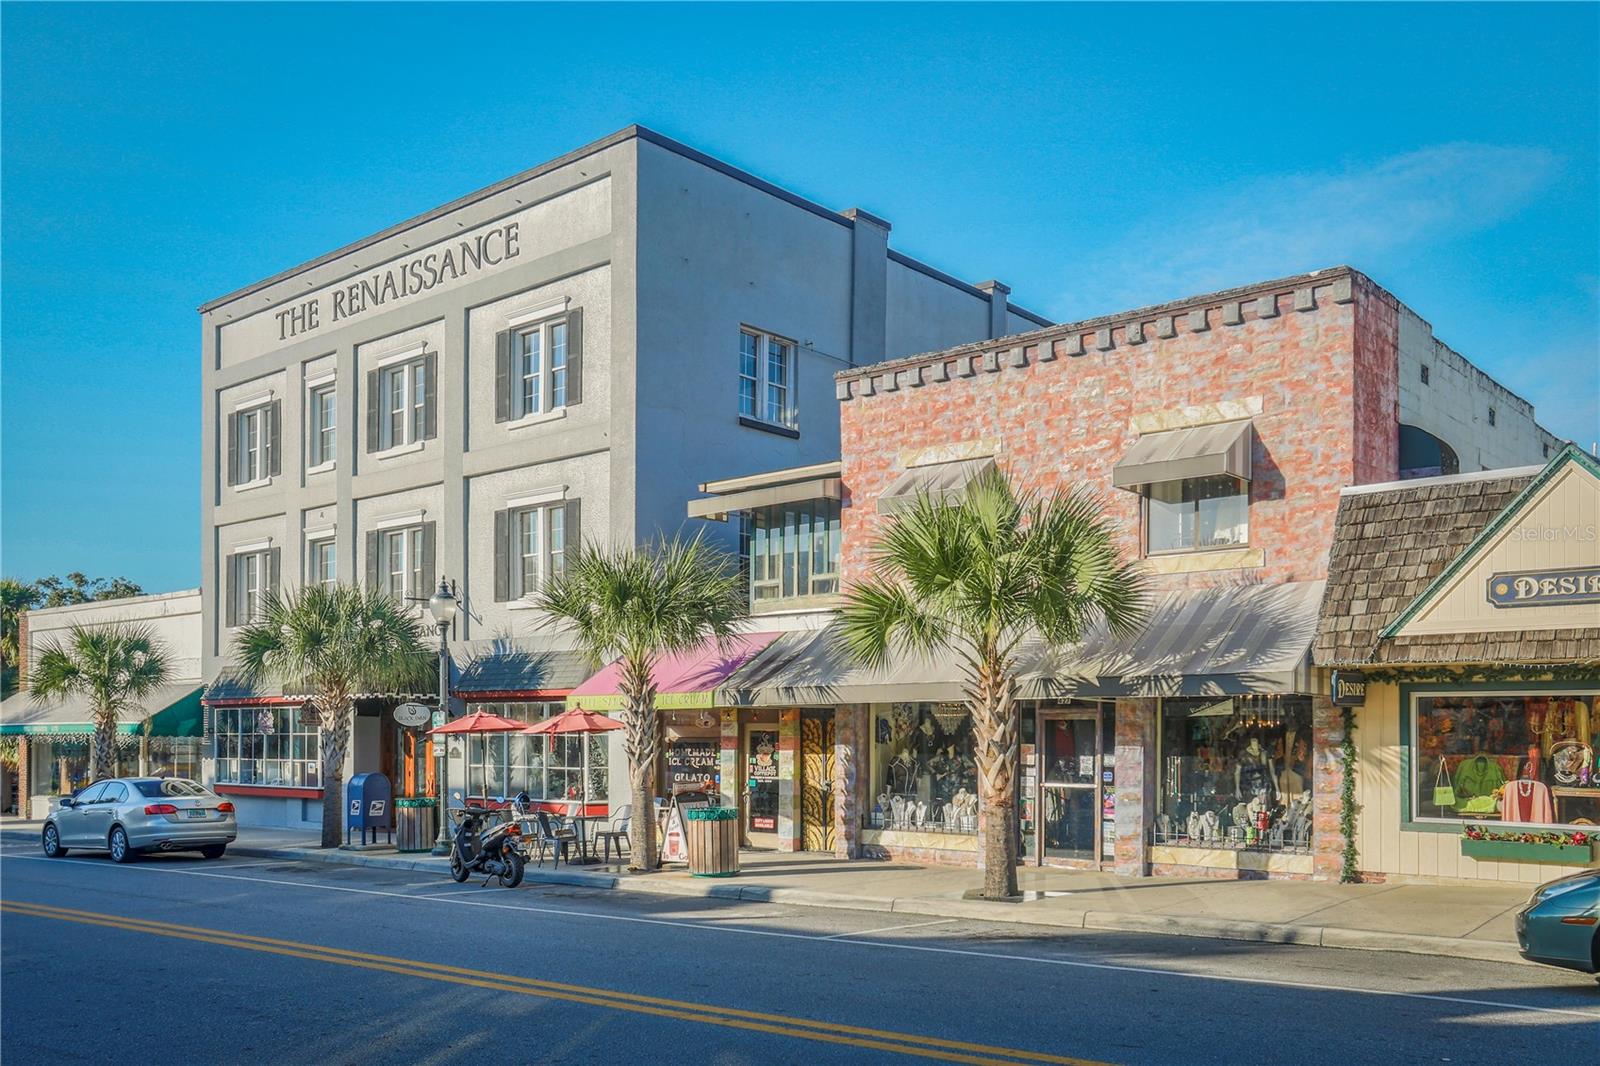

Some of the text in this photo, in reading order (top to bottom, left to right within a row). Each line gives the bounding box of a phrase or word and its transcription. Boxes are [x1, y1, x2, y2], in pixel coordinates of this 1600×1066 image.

[275, 222, 520, 340] THE RENAISSANCE
[668, 747, 716, 757] HOMEMADE
[684, 757, 714, 768] CREAM
[674, 773, 711, 782] GELATO
